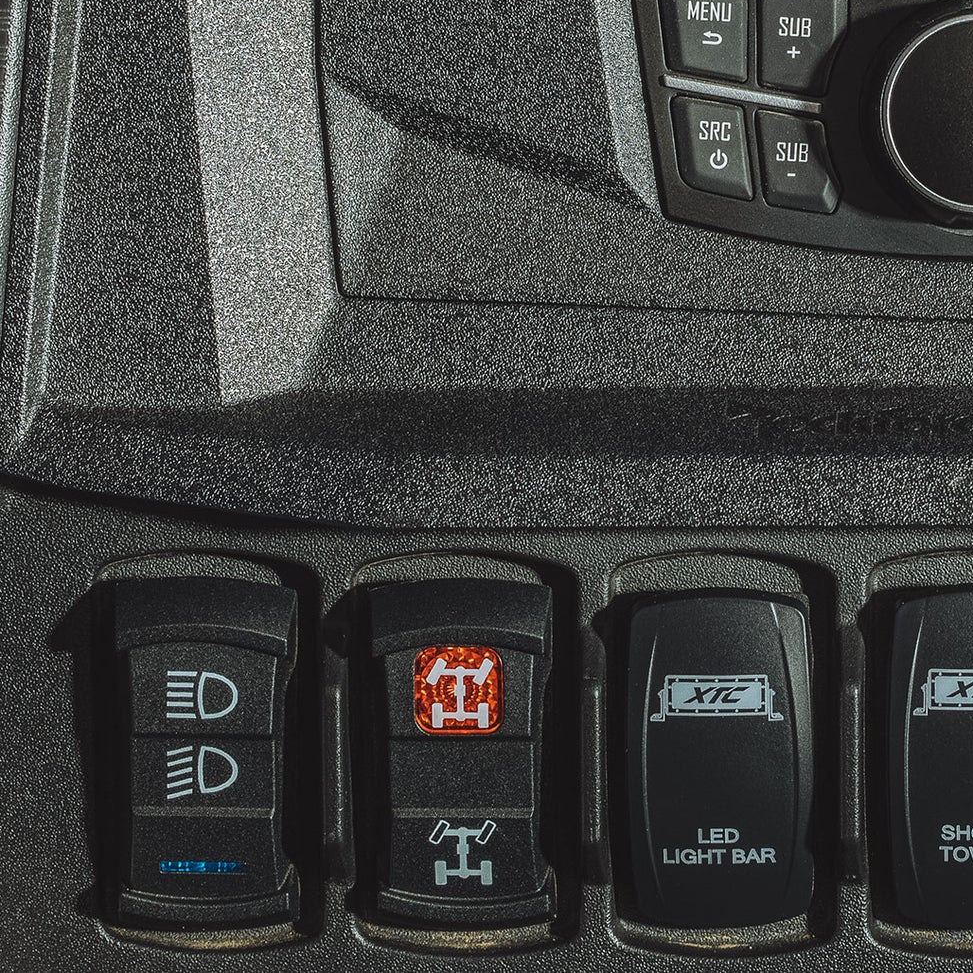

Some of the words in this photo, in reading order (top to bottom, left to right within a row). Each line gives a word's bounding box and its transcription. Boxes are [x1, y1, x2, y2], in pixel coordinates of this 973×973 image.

[687, 0, 732, 23] MENU
[778, 16, 812, 38] SUB
[698, 120, 732, 142] SRC
[775, 141, 809, 163] SUB
[683, 686, 750, 704] XTC
[697, 827, 740, 844] LED
[662, 848, 727, 865] LIGHT
[731, 847, 777, 865] BAR
